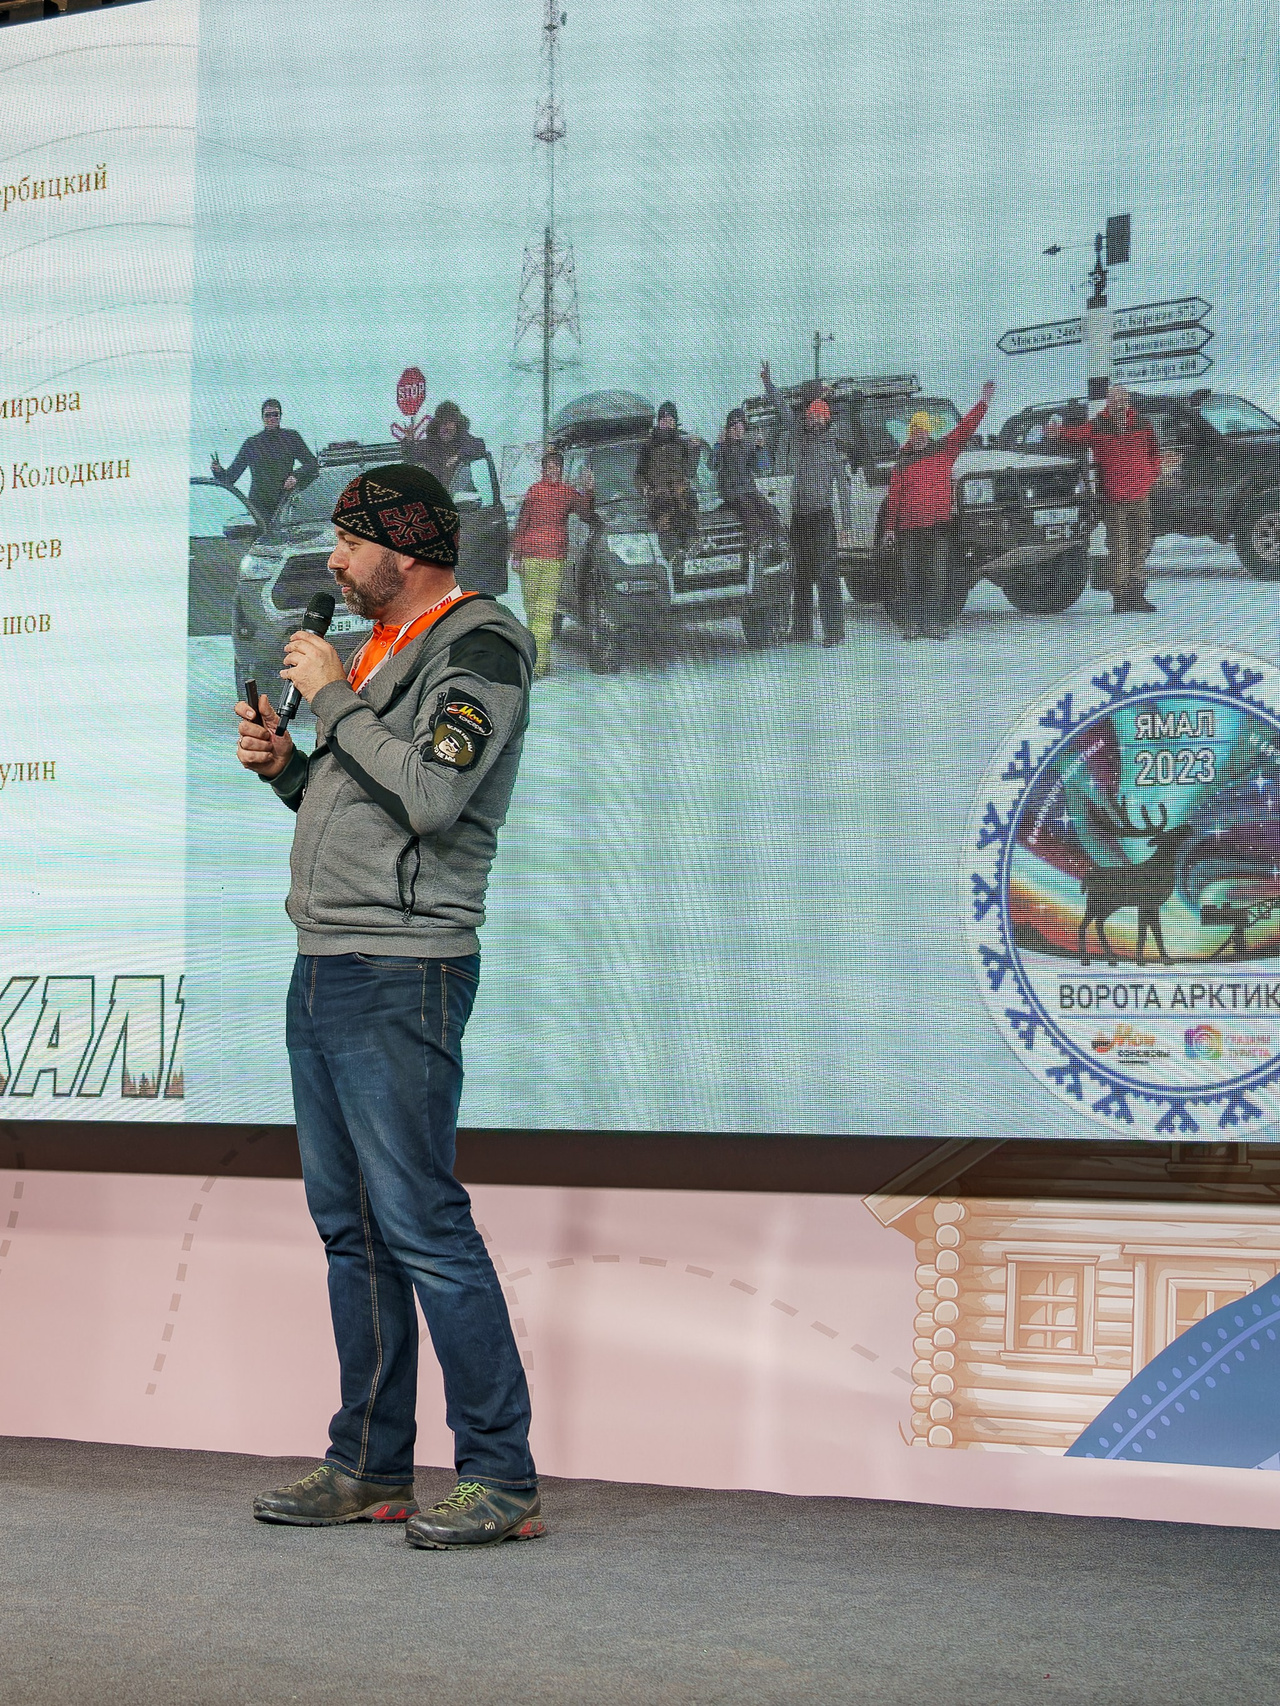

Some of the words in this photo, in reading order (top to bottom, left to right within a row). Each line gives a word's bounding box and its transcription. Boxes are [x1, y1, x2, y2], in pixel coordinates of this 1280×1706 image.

[398, 382, 425, 400] STOP
[12, 459, 131, 492] Колодкин
[1135, 709, 1214, 740] ЯМАЛ
[1135, 748, 1217, 787] 2023
[1060, 983, 1161, 1010] ВОРОТА
